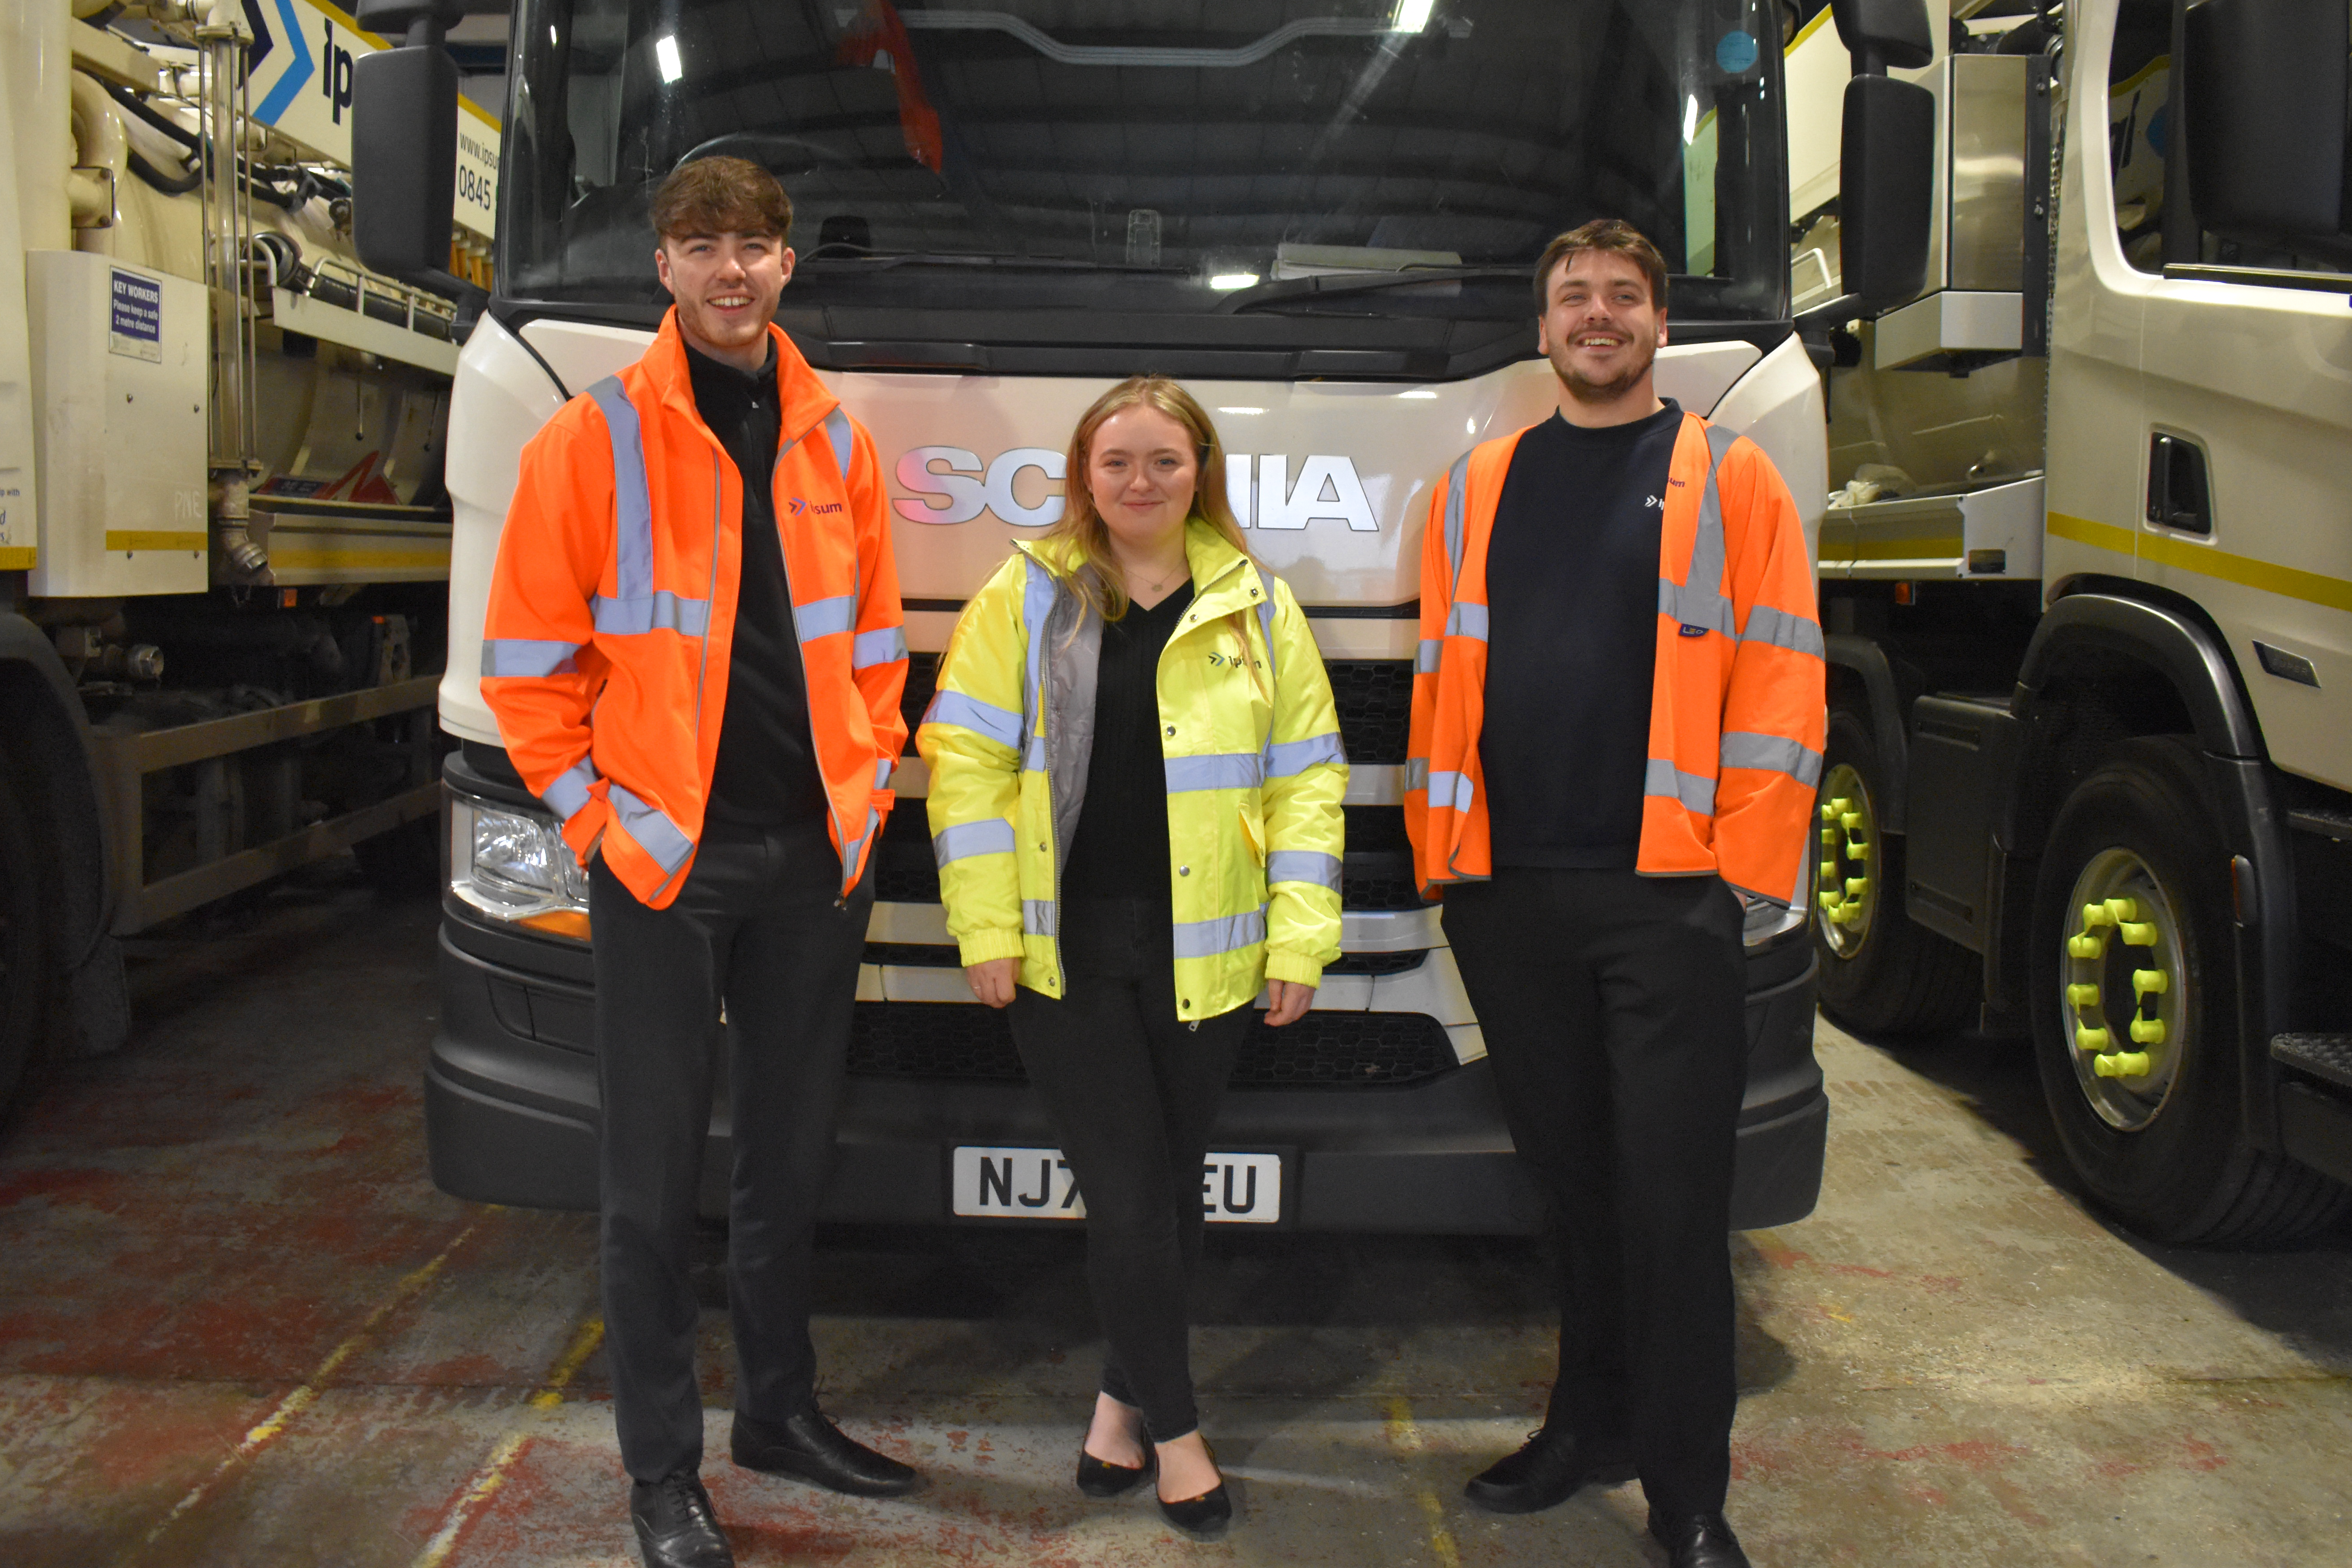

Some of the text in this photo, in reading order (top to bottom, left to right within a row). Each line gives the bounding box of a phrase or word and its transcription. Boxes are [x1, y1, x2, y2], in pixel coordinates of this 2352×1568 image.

[460, 133, 499, 172] www.ipsu
[459, 164, 491, 211] 0845
[113, 279, 158, 303] KEY WORKERS
[113, 299, 158, 320] Please keep a safe
[116, 314, 156, 334] 2 metre distance
[892, 445, 1380, 532] SCIA
[979, 1156, 1257, 1214] NJ7 EU
